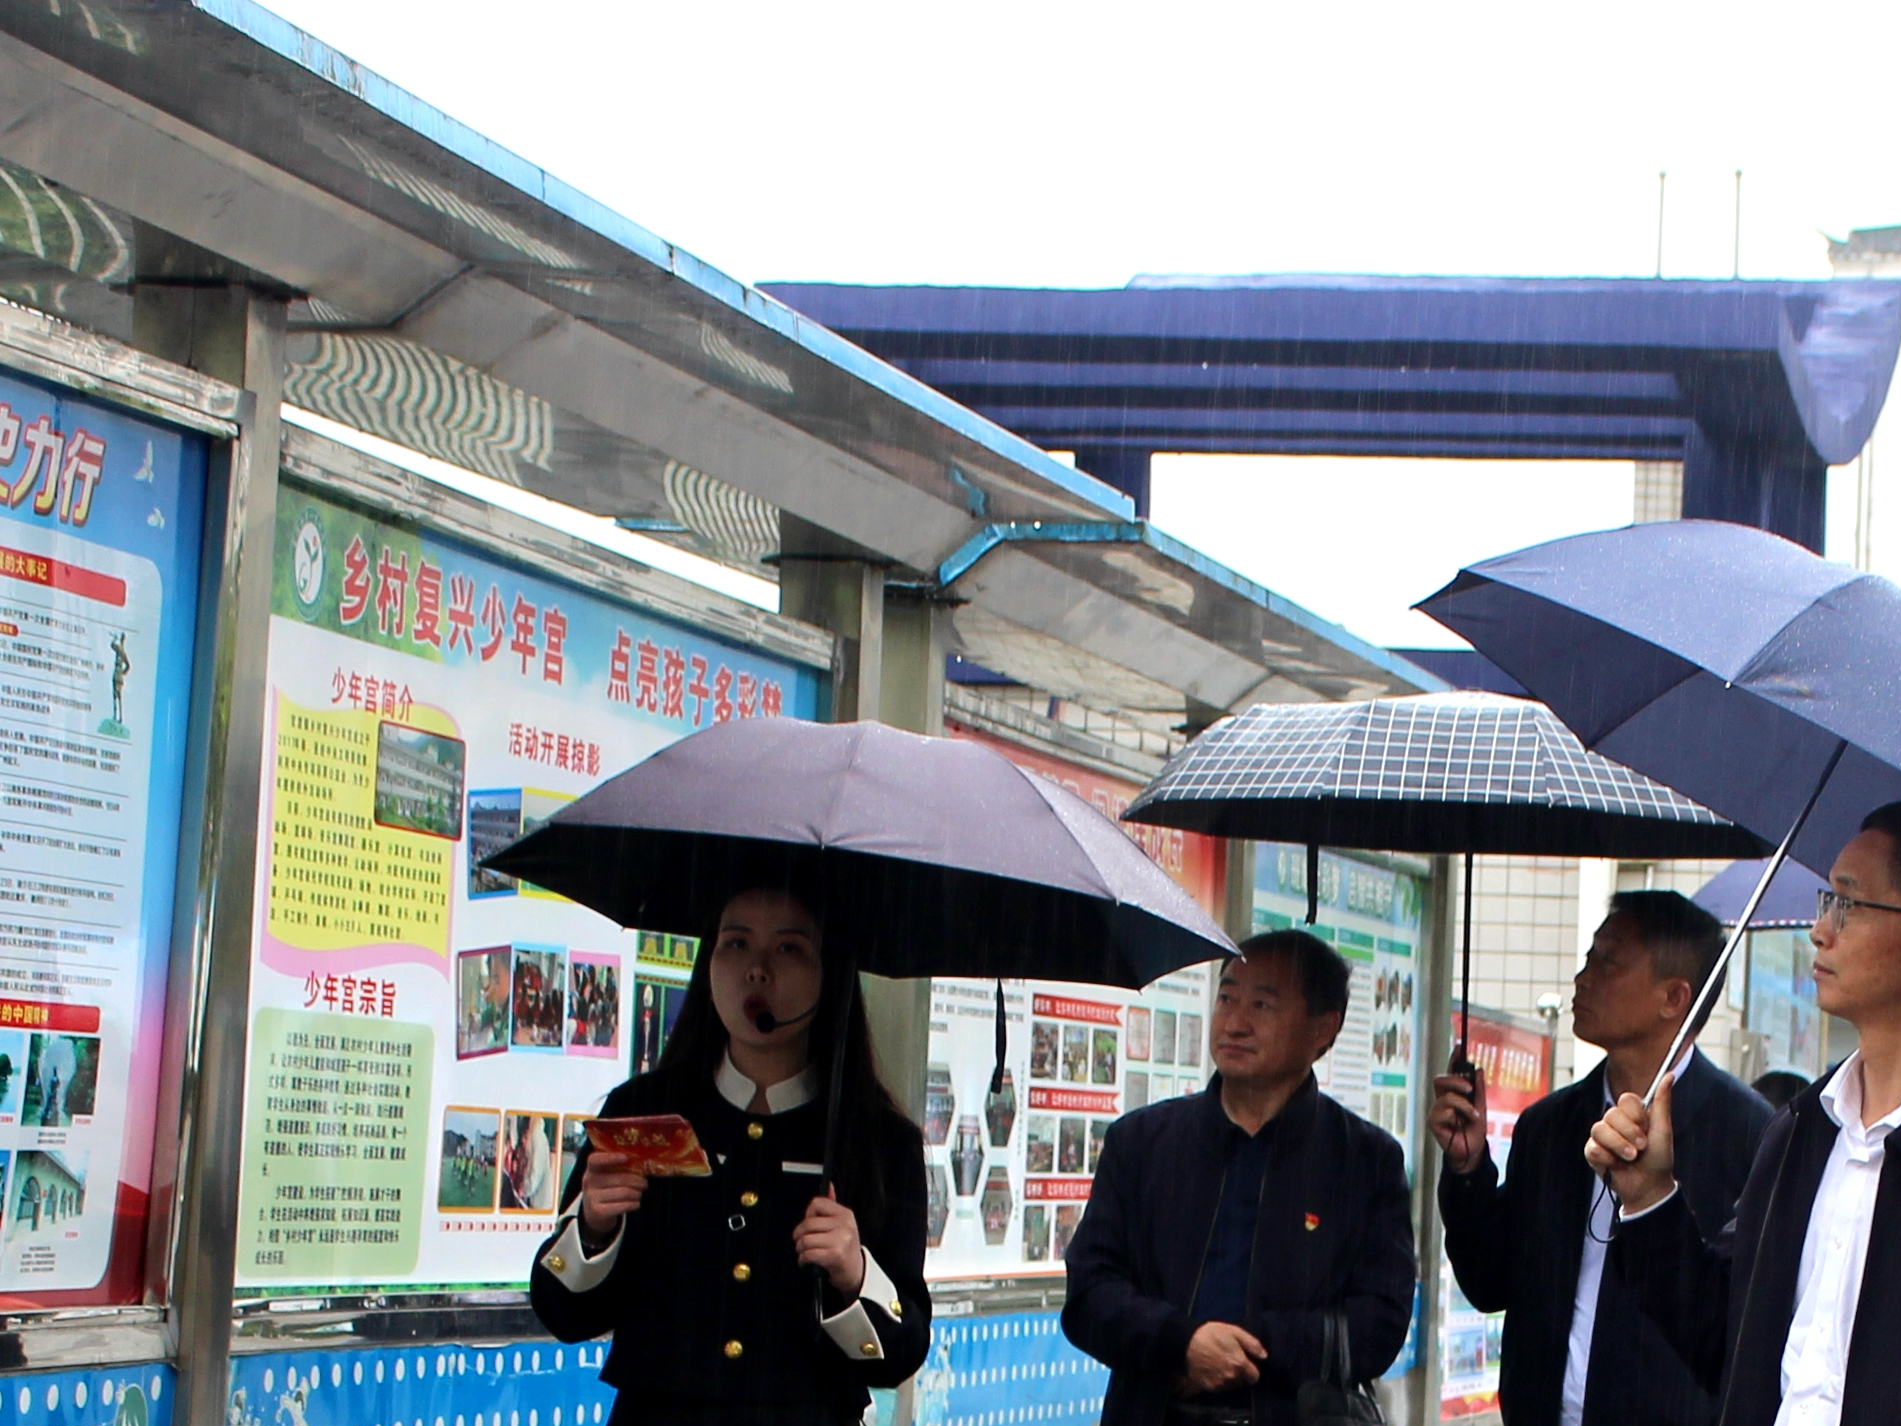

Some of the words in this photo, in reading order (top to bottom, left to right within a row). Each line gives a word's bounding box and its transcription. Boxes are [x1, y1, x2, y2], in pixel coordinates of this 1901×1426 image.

[340, 535, 567, 685] 乡村复兴少年宫
[332, 666, 414, 721] 少年宫简介
[508, 722, 602, 776] 活动开展掠影
[303, 970, 397, 1017] 少年宫宗旨
